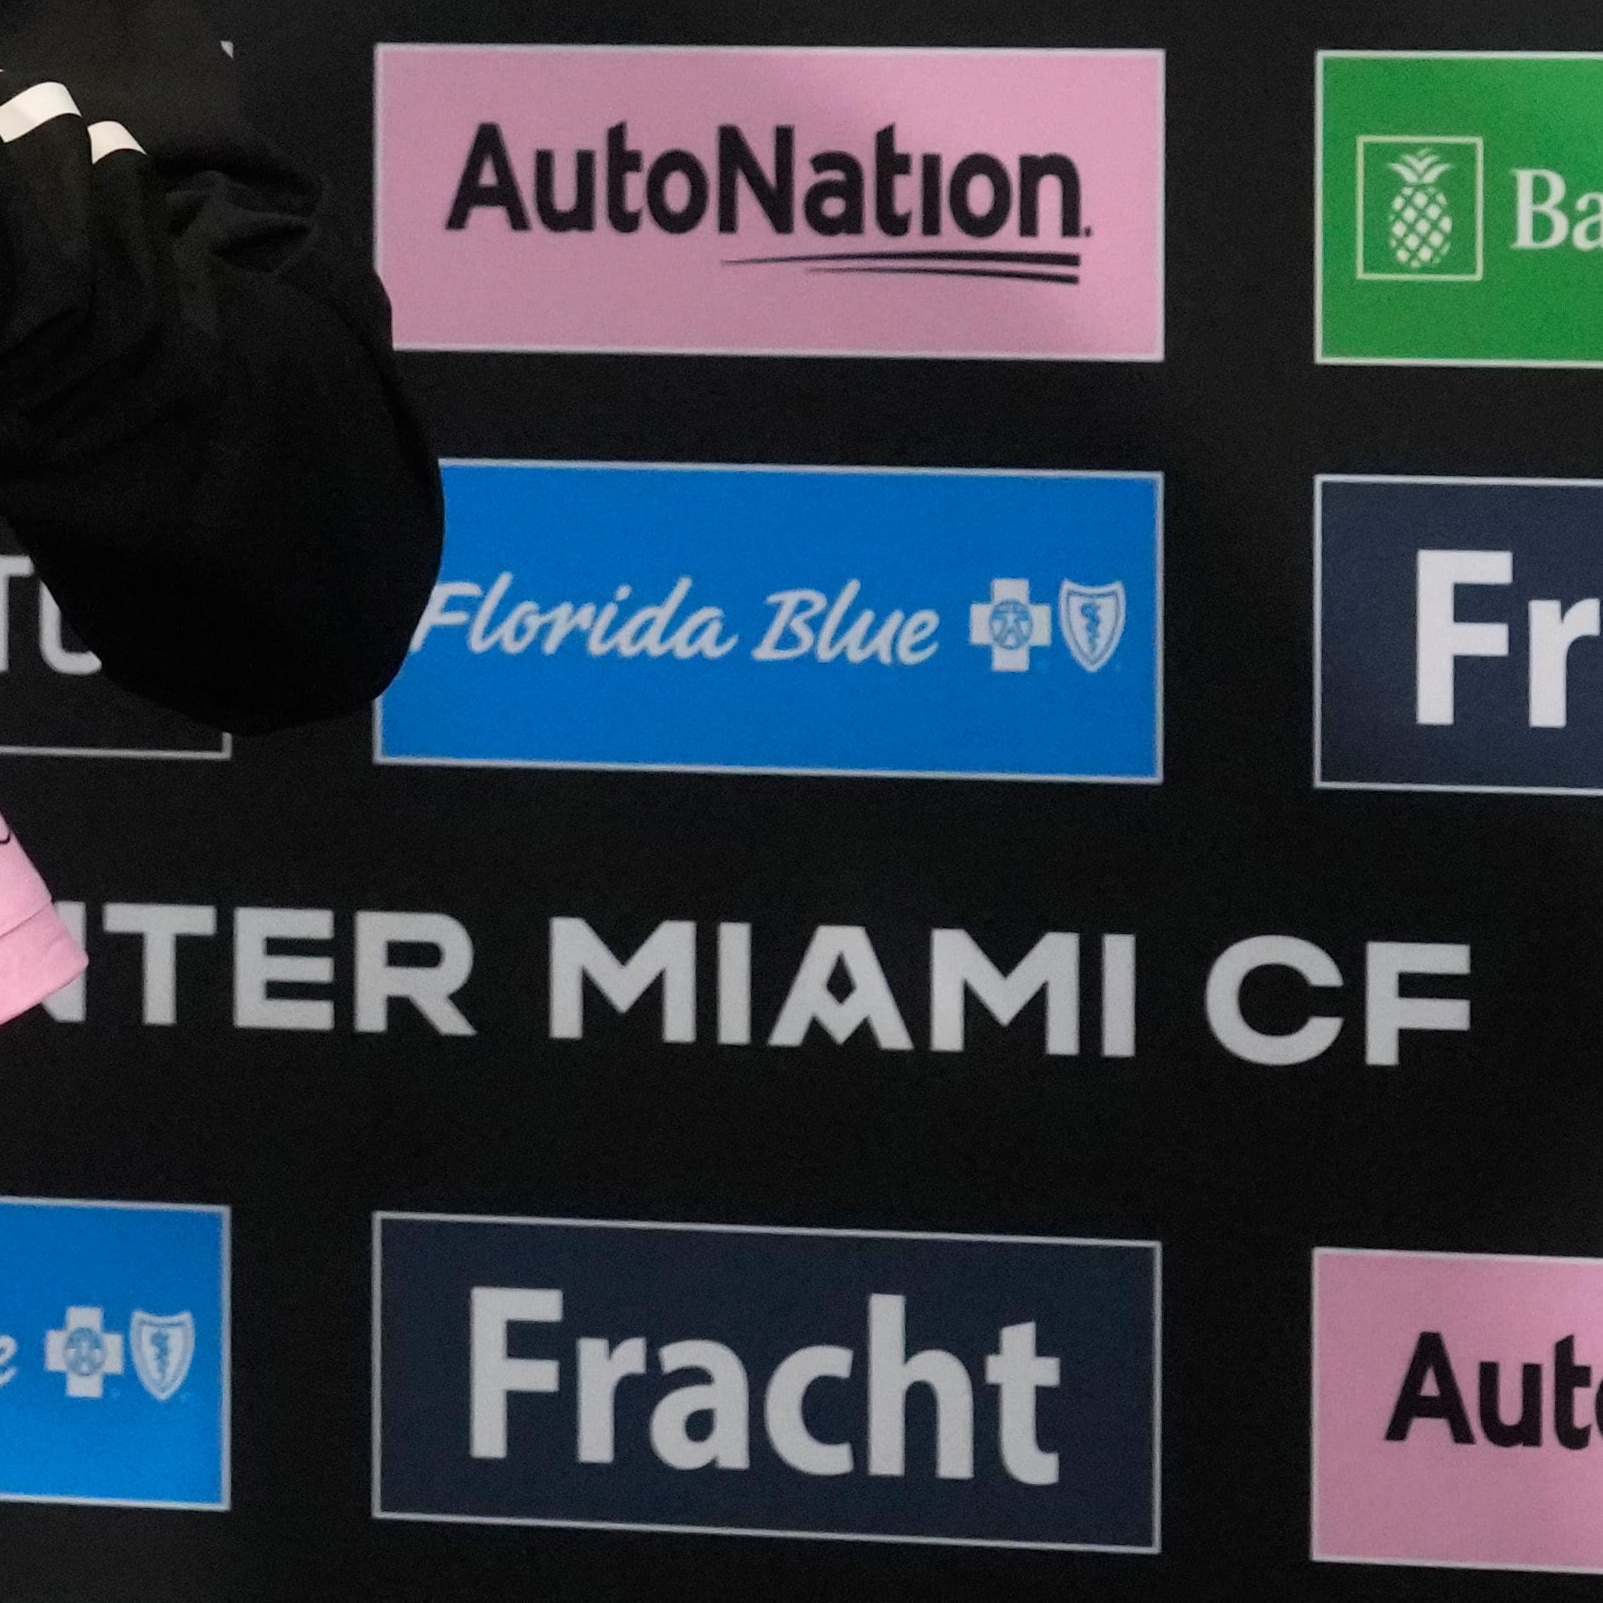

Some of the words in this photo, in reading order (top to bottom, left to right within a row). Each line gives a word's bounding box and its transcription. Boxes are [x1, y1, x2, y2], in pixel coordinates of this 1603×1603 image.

[444, 120, 1084, 240] AutoNation
[408, 571, 739, 660] Florida
[752, 577, 941, 666] Blue
[549, 915, 1136, 1058] MIAMI
[1204, 934, 1472, 1067] CF
[469, 1285, 1061, 1486] Fracht
